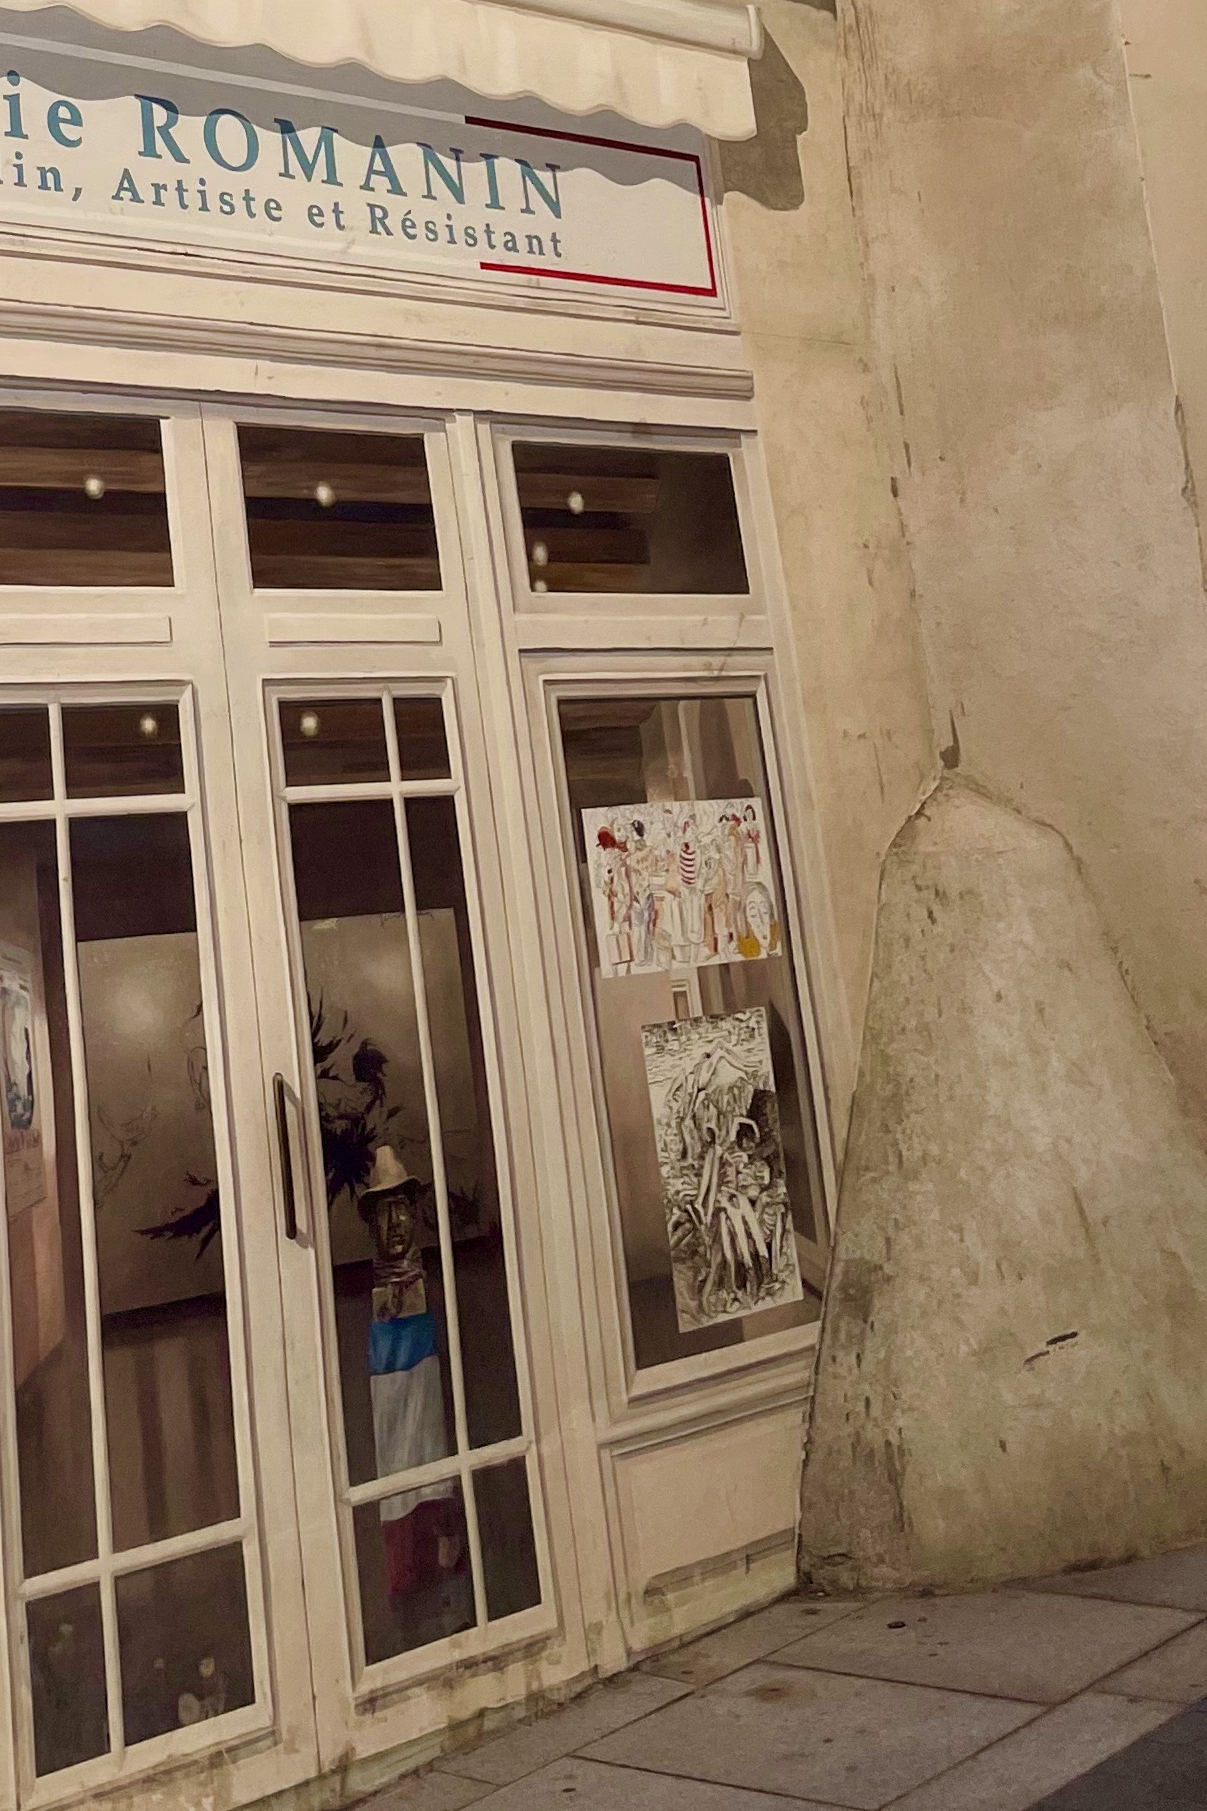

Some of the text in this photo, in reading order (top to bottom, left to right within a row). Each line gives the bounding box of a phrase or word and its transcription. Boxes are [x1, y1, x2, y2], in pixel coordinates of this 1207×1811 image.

[134, 94, 563, 220] ROMANIN
[111, 167, 283, 222] Artiste
[307, 201, 346, 231] et
[366, 202, 564, 259] Résistant
